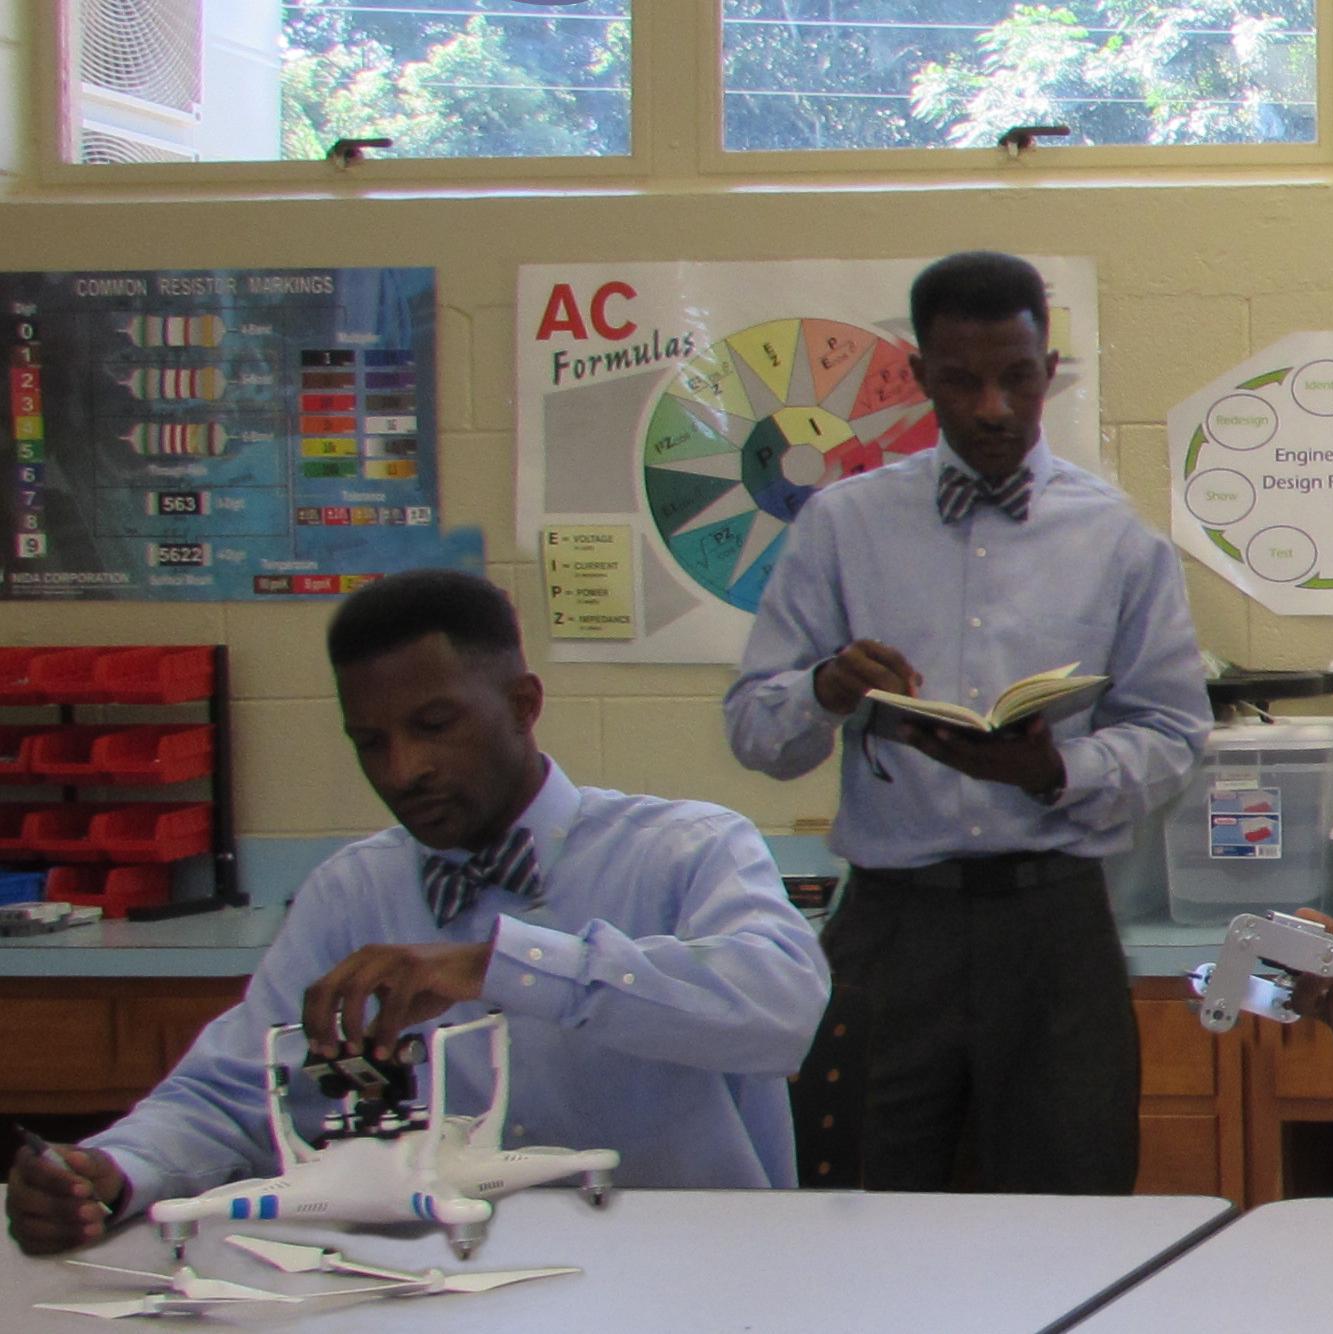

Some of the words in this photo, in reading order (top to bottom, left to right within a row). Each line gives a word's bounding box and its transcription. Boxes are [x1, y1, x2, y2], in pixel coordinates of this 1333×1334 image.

[75, 279, 148, 297] COMMON
[159, 277, 237, 296] RESISTOR
[249, 276, 335, 295] MARKINGS
[536, 280, 638, 341] AC
[20, 323, 34, 340] 0
[22, 348, 32, 362] 1
[552, 329, 696, 386] Formulas
[21, 373, 34, 388] 2
[22, 398, 35, 413] 3
[807, 416, 822, 437] I
[1216, 414, 1269, 428] Redesign
[18, 443, 35, 459] 5
[756, 446, 773, 469] P
[23, 467, 36, 483] 6
[1262, 474, 1322, 493] Design
[23, 491, 36, 506] 7
[1206, 490, 1238, 501] Show
[162, 497, 197, 512] 563
[25, 514, 38, 530] 8
[27, 538, 41, 554] 9
[549, 532, 559, 545] E
[573, 534, 614, 543] VOLTAGE
[159, 549, 203, 563] 5622
[1270, 547, 1293, 558] Test
[574, 561, 618, 570] CURRENT
[44, 572, 130, 584] CORPORATION
[551, 585, 562, 598] P
[576, 588, 609, 597] POWER
[554, 612, 565, 625] Z
[578, 615, 630, 624] IMPEDANCE
